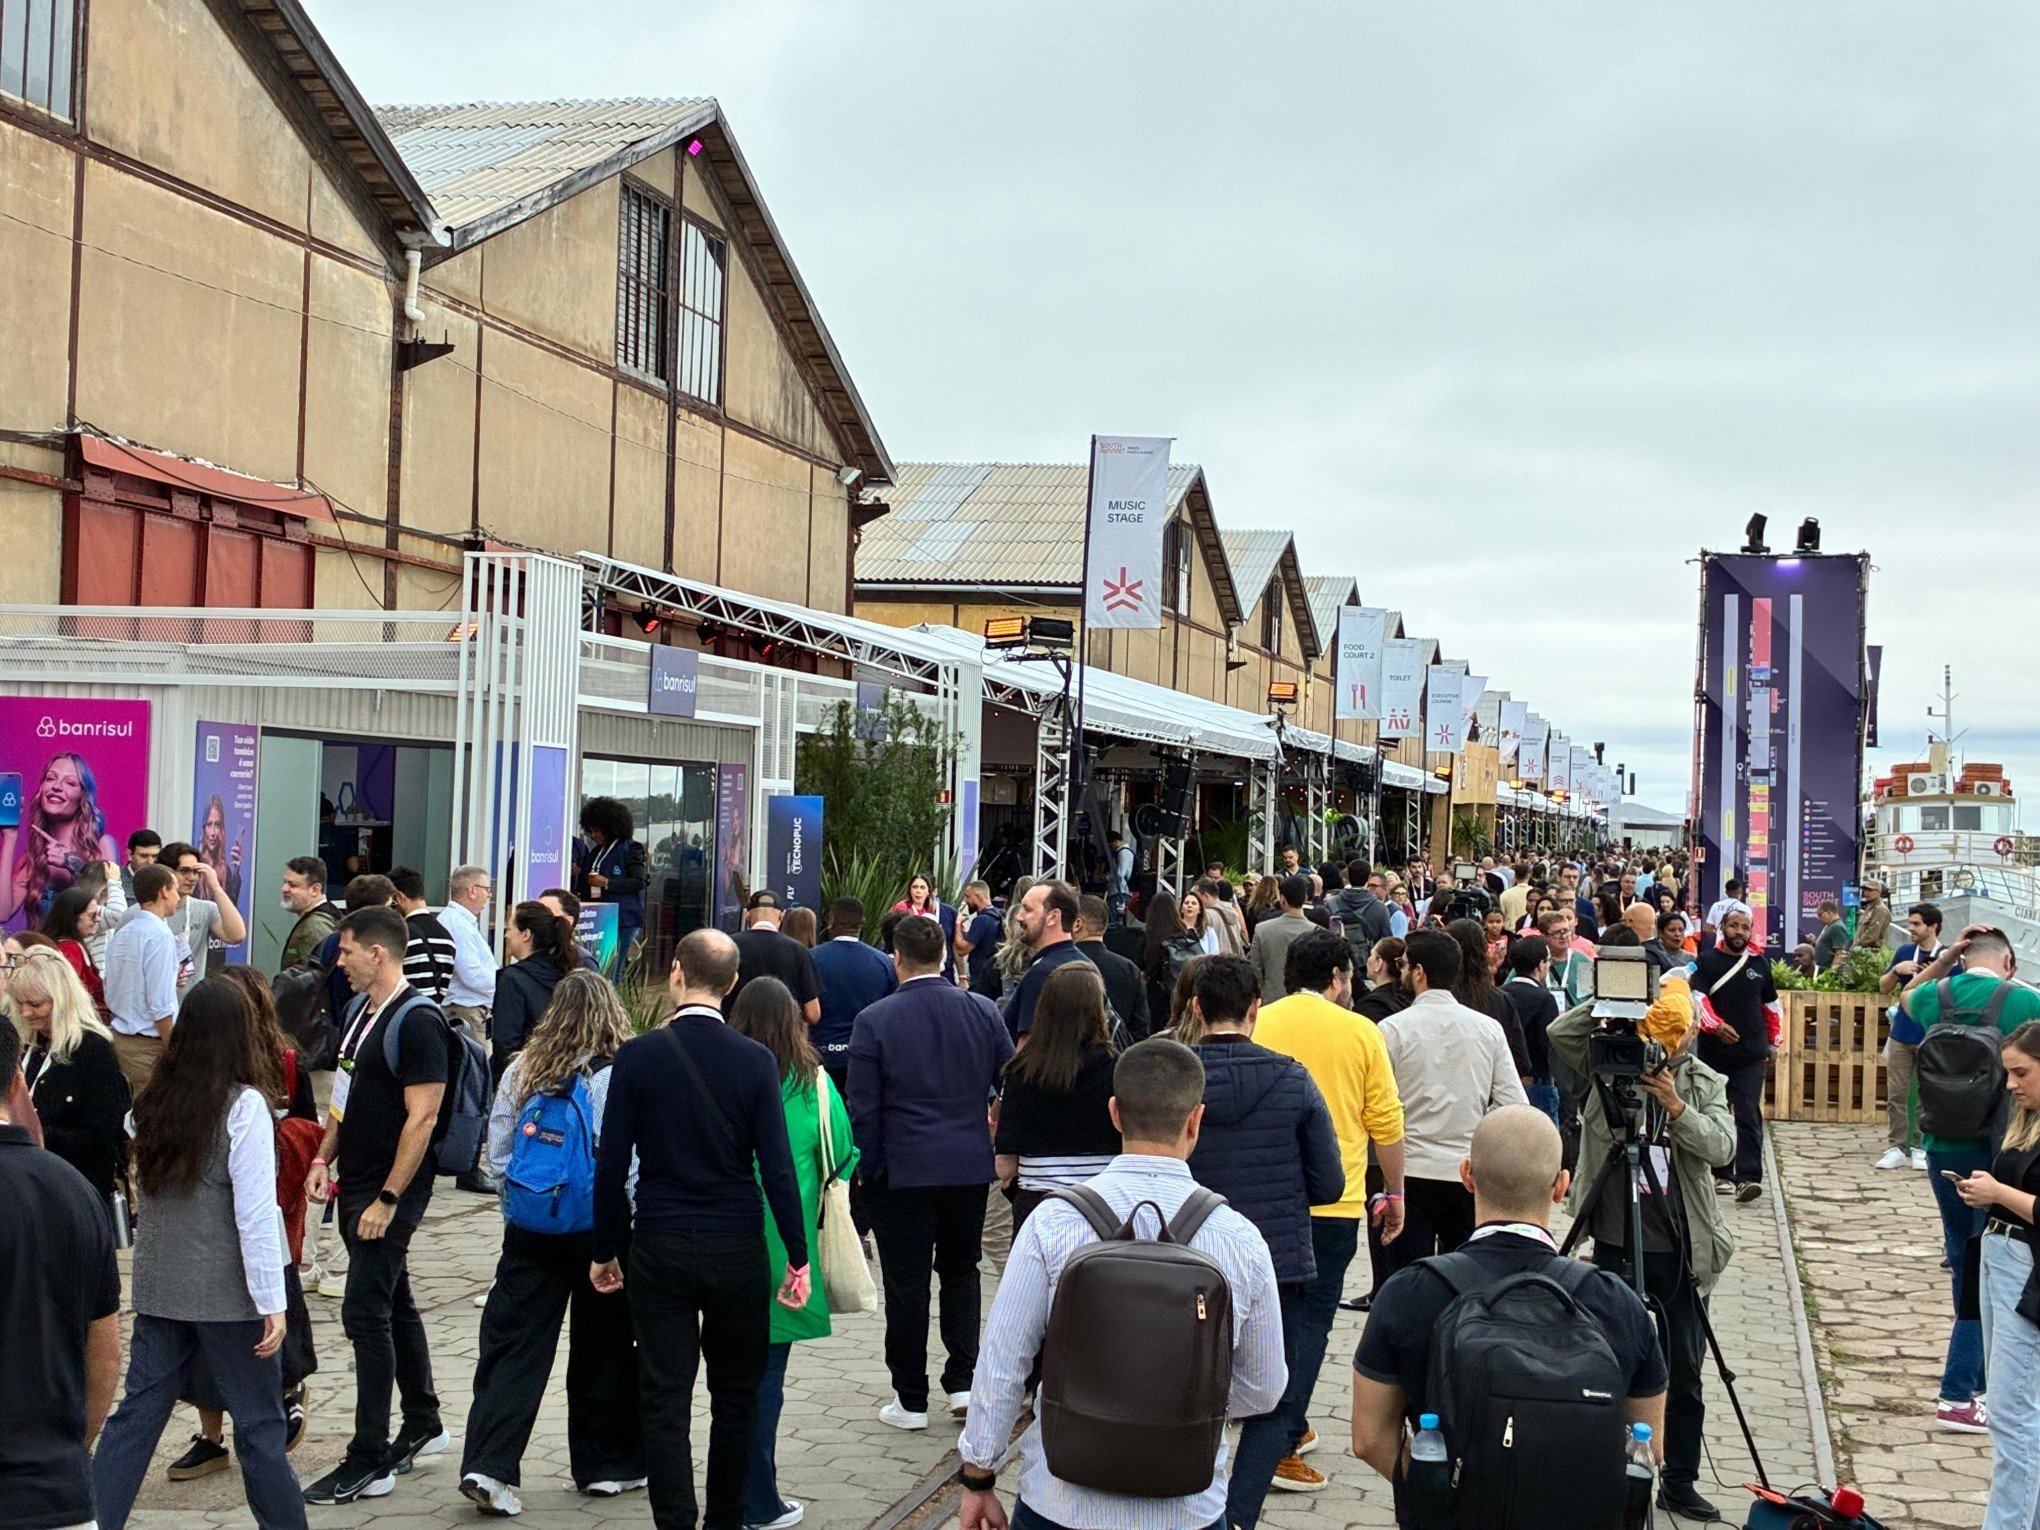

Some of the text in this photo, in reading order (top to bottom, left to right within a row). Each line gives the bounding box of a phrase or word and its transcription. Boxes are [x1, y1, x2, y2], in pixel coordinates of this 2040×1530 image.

[1108, 500, 1146, 510] MUSIC
[1107, 513, 1144, 523] STAGE
[663, 671, 696, 693] banrisul
[59, 719, 133, 737] banrisul
[790, 816, 803, 875] TECNOPUC
[531, 848, 559, 864] banrisul
[787, 885, 795, 900] FLY
[1802, 891, 1834, 899] SOUTH
